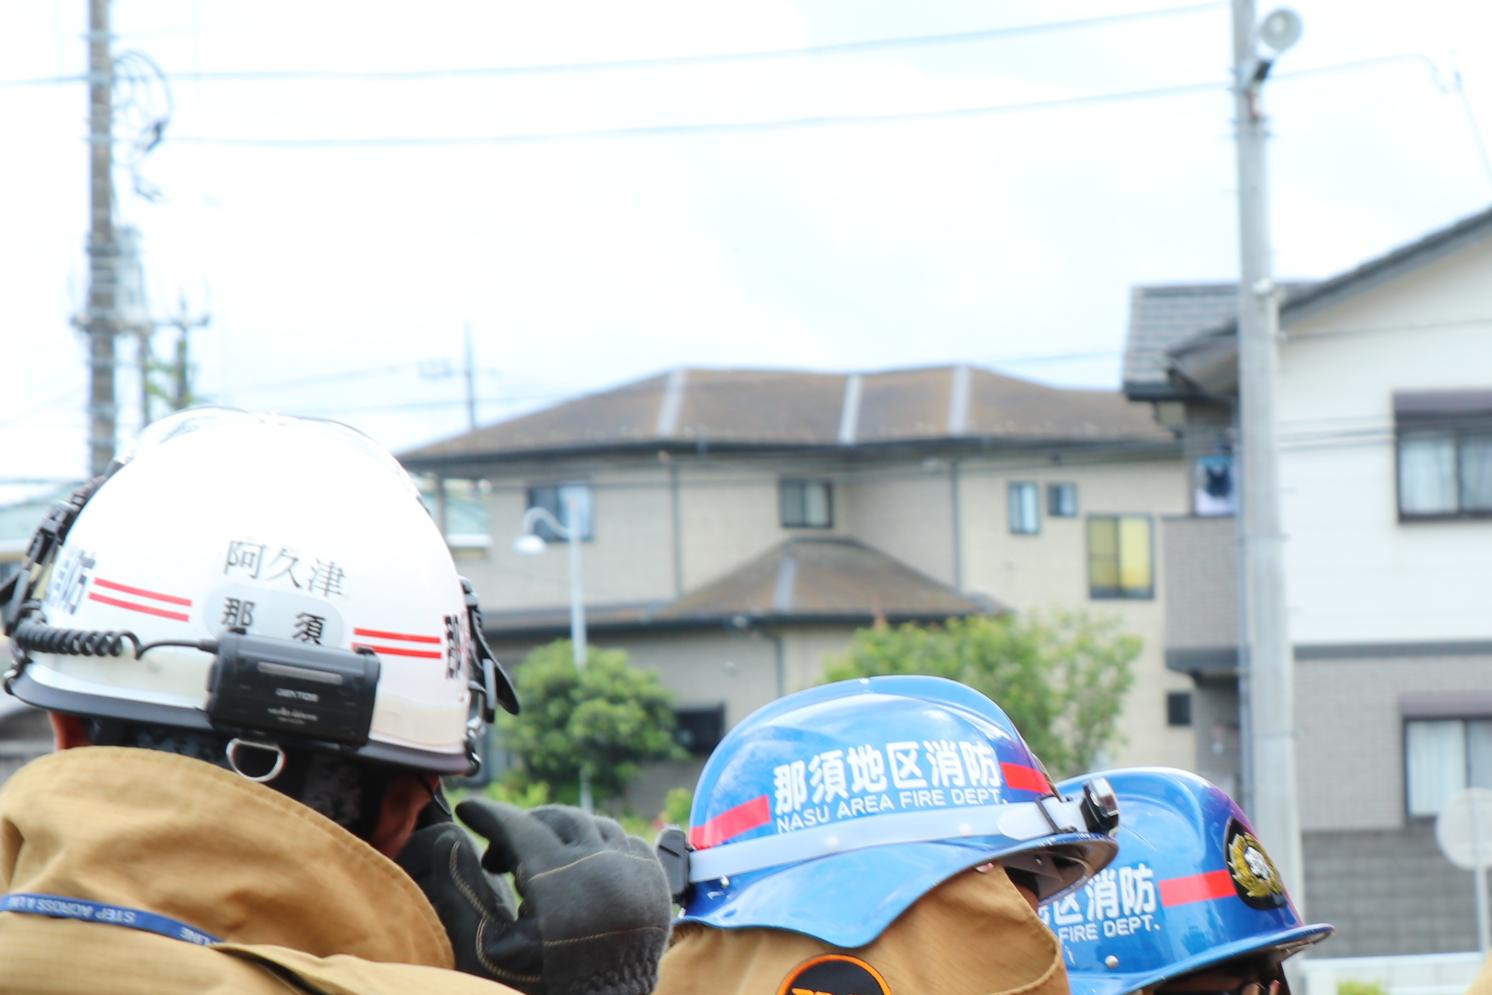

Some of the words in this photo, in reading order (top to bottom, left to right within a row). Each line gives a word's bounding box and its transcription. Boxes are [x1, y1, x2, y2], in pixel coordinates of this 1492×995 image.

[223, 540, 346, 597] 阿久津
[221, 597, 327, 645] 那須
[773, 740, 1002, 816] 那須地区消防
[776, 804, 831, 834] NASU
[837, 793, 896, 819] AREA
[899, 788, 947, 808] FIRE
[951, 787, 1008, 806] DEPT.
[1058, 923, 1099, 943] FIRE
[1103, 914, 1161, 938] DEPT.
